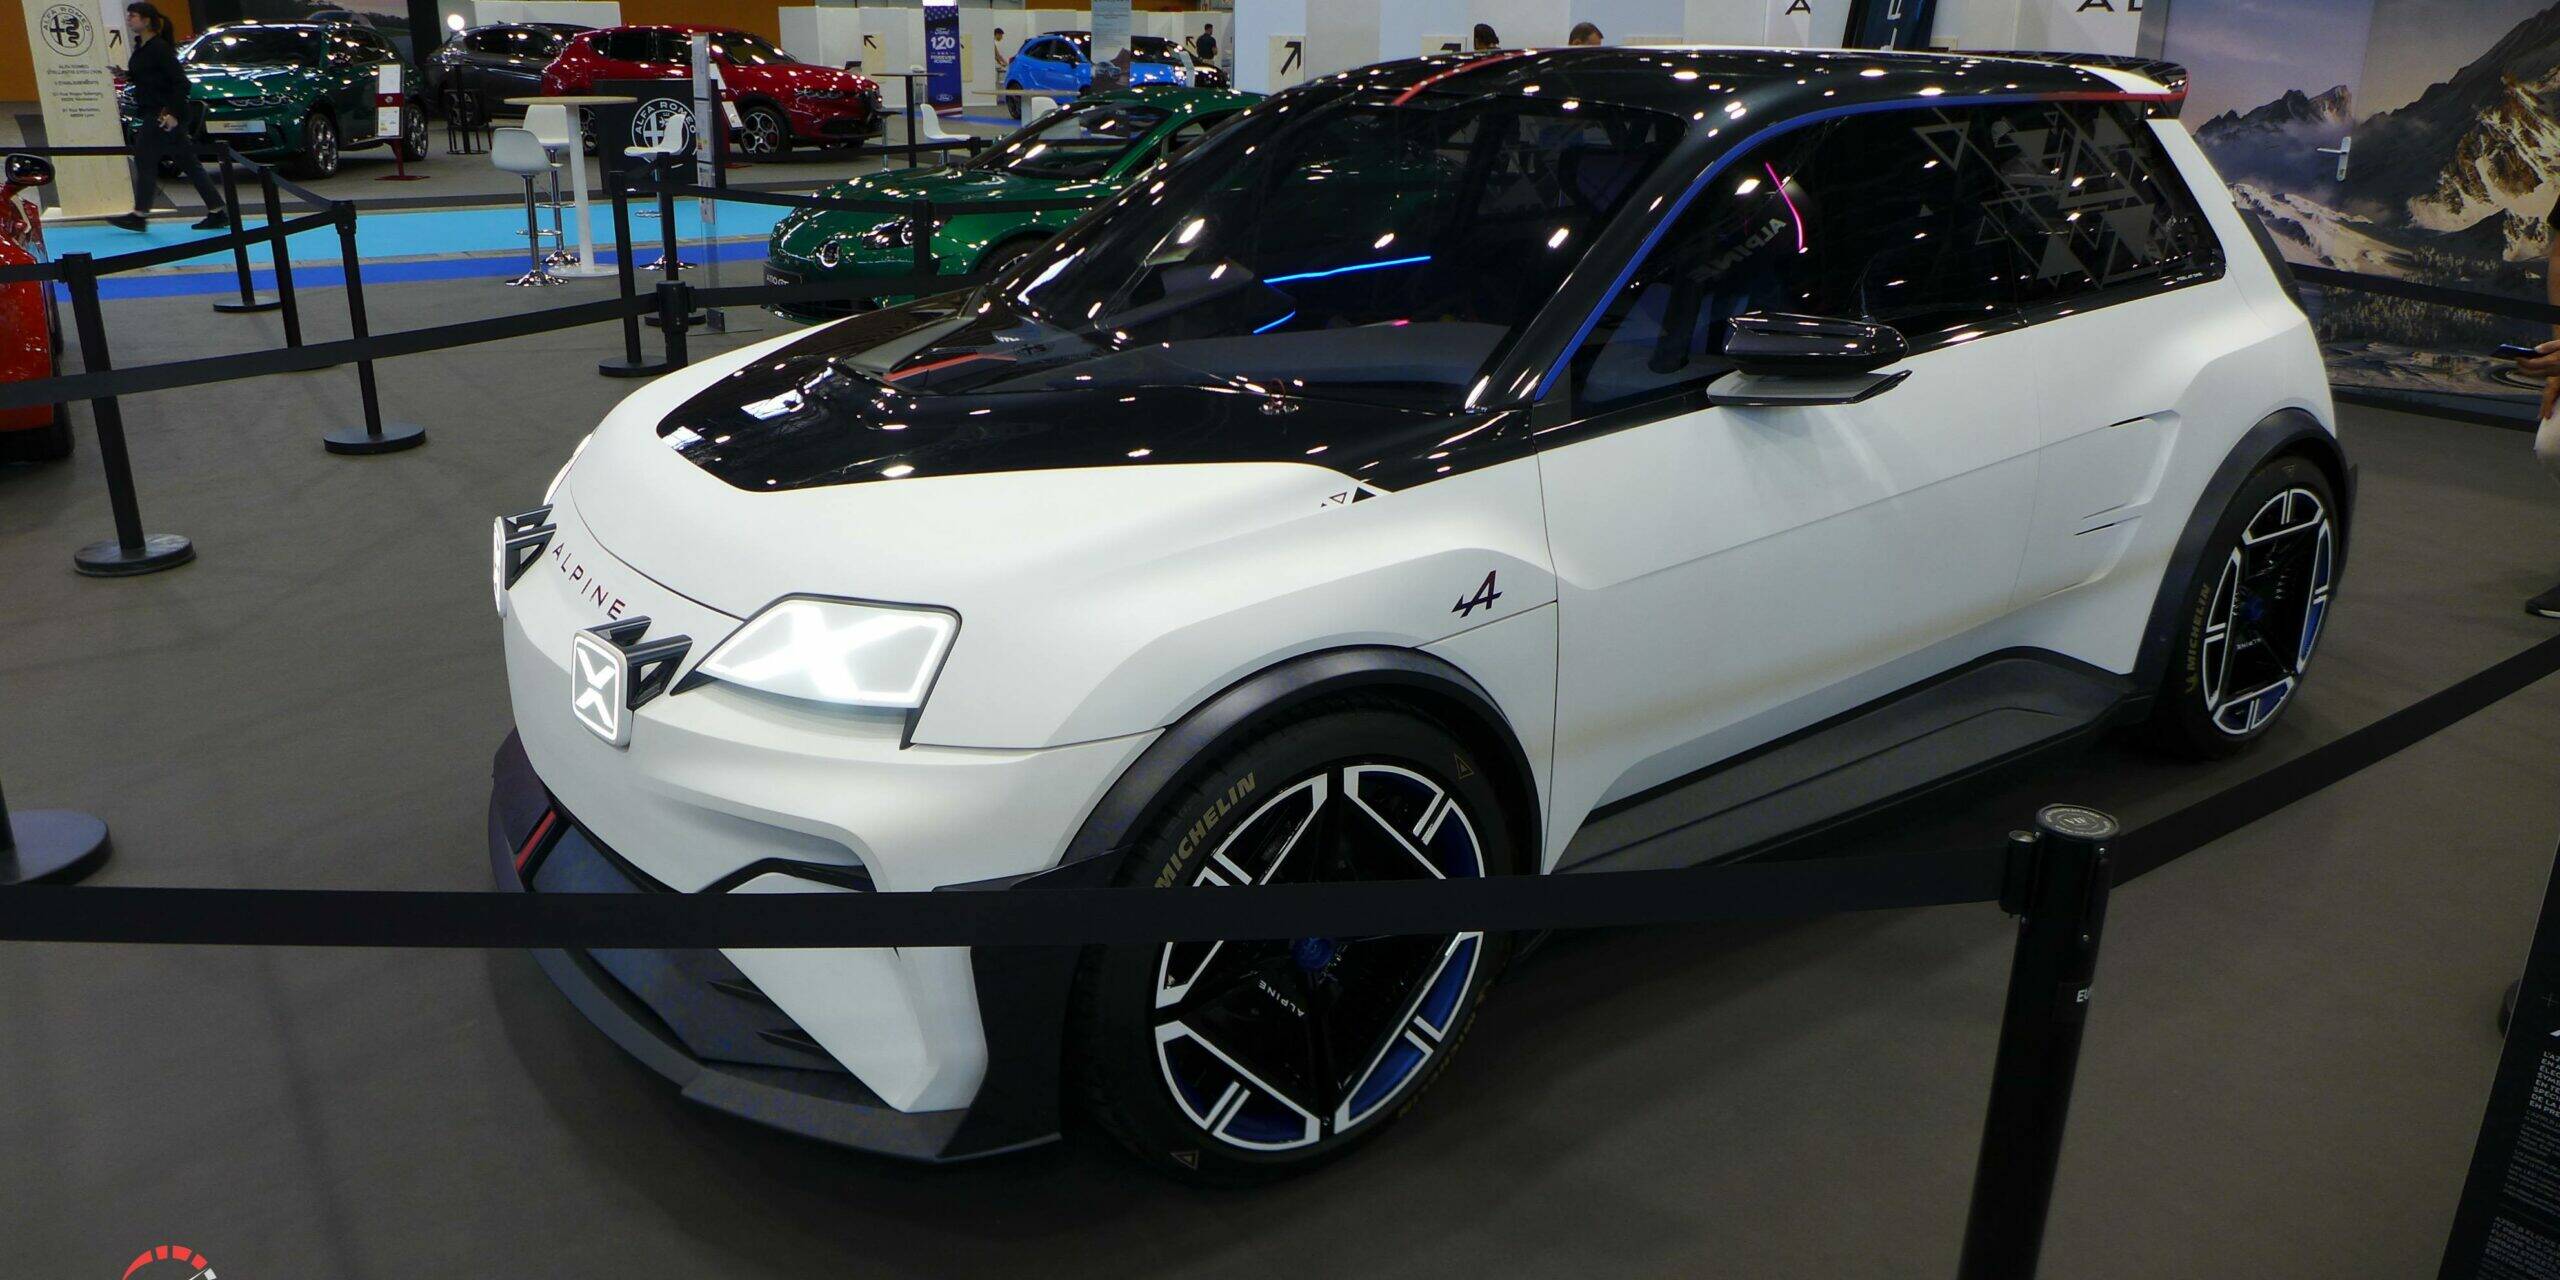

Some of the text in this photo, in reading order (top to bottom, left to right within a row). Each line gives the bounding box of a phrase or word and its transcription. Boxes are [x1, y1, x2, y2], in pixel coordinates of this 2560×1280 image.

[43, 7, 91, 31] ALFA ROMEO
[930, 36, 956, 50] 120
[635, 106, 655, 134] ALFA
[552, 543, 627, 621] ALPINE
[1154, 770, 1257, 888] MICHELIN
[1257, 979, 1305, 1017] ALPINE
